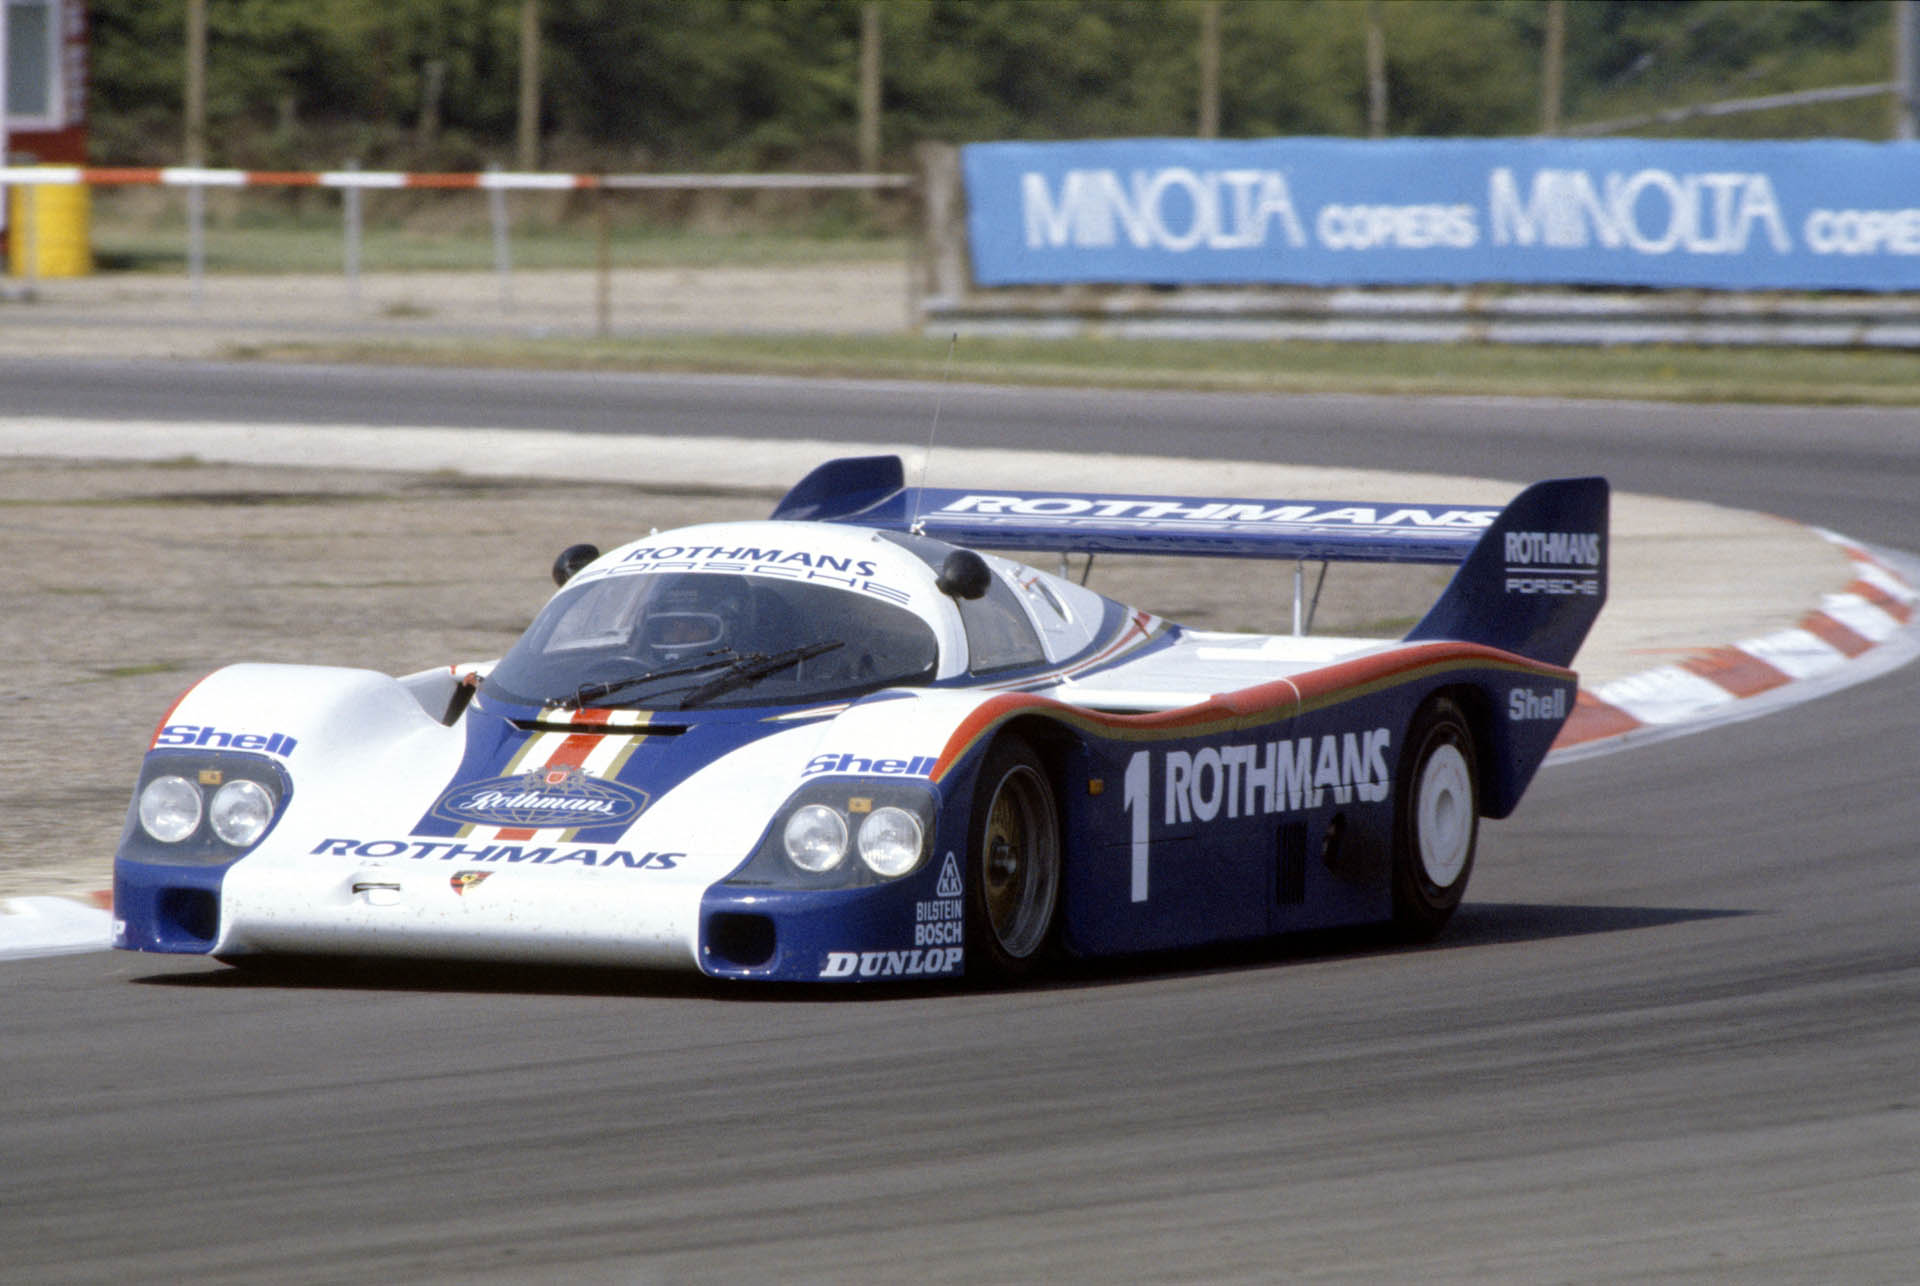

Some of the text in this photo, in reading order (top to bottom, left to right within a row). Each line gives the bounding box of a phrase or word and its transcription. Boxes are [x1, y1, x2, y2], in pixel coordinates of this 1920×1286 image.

[1021, 167, 1479, 250] MINOLTA COPIERS
[1489, 167, 1793, 255] MINOLTA
[942, 495, 1500, 527] ROTHMANS
[622, 546, 877, 577] ROTHMANS
[1505, 531, 1599, 566] ROTHMANS
[1505, 578, 1598, 595] PORSCHE
[1508, 688, 1566, 721] Shell
[157, 726, 297, 757] Shell
[803, 754, 938, 776] Shell
[1166, 728, 1391, 825] ROTHMANS
[459, 791, 616, 815] Rothmans
[1123, 750, 1151, 904] 1
[310, 838, 687, 870] ROTHMANS
[916, 900, 962, 921] BILSTEIN
[915, 922, 962, 945] BOSCH
[820, 948, 963, 977] DUNLOP
